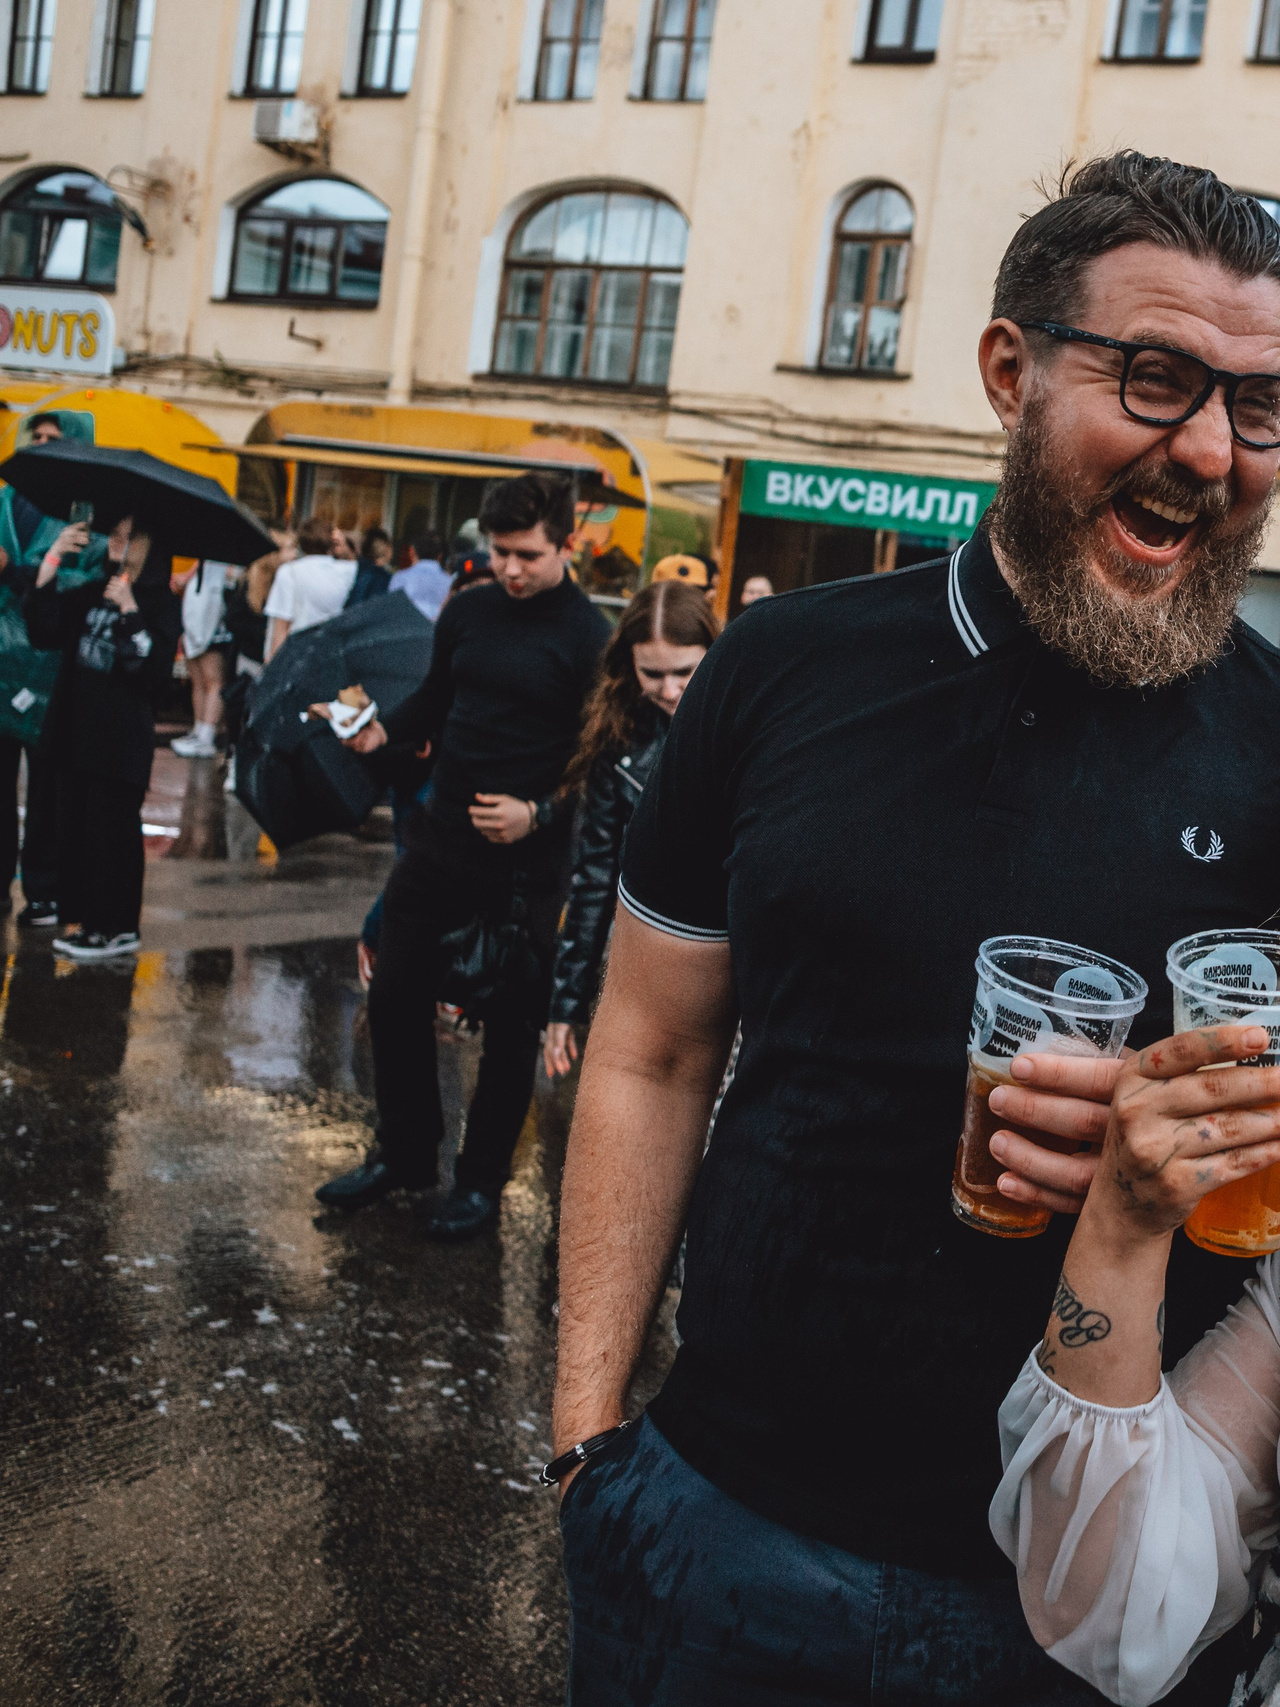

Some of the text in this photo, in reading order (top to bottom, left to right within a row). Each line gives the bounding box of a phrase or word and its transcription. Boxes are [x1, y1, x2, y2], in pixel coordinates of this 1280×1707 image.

[765, 470, 979, 527] ВКУСВИЛЛ
[994, 1016, 1037, 1043] ПИВОВАРНЯ
[995, 1003, 1042, 1032] ВОЛКОВСКАЯ
